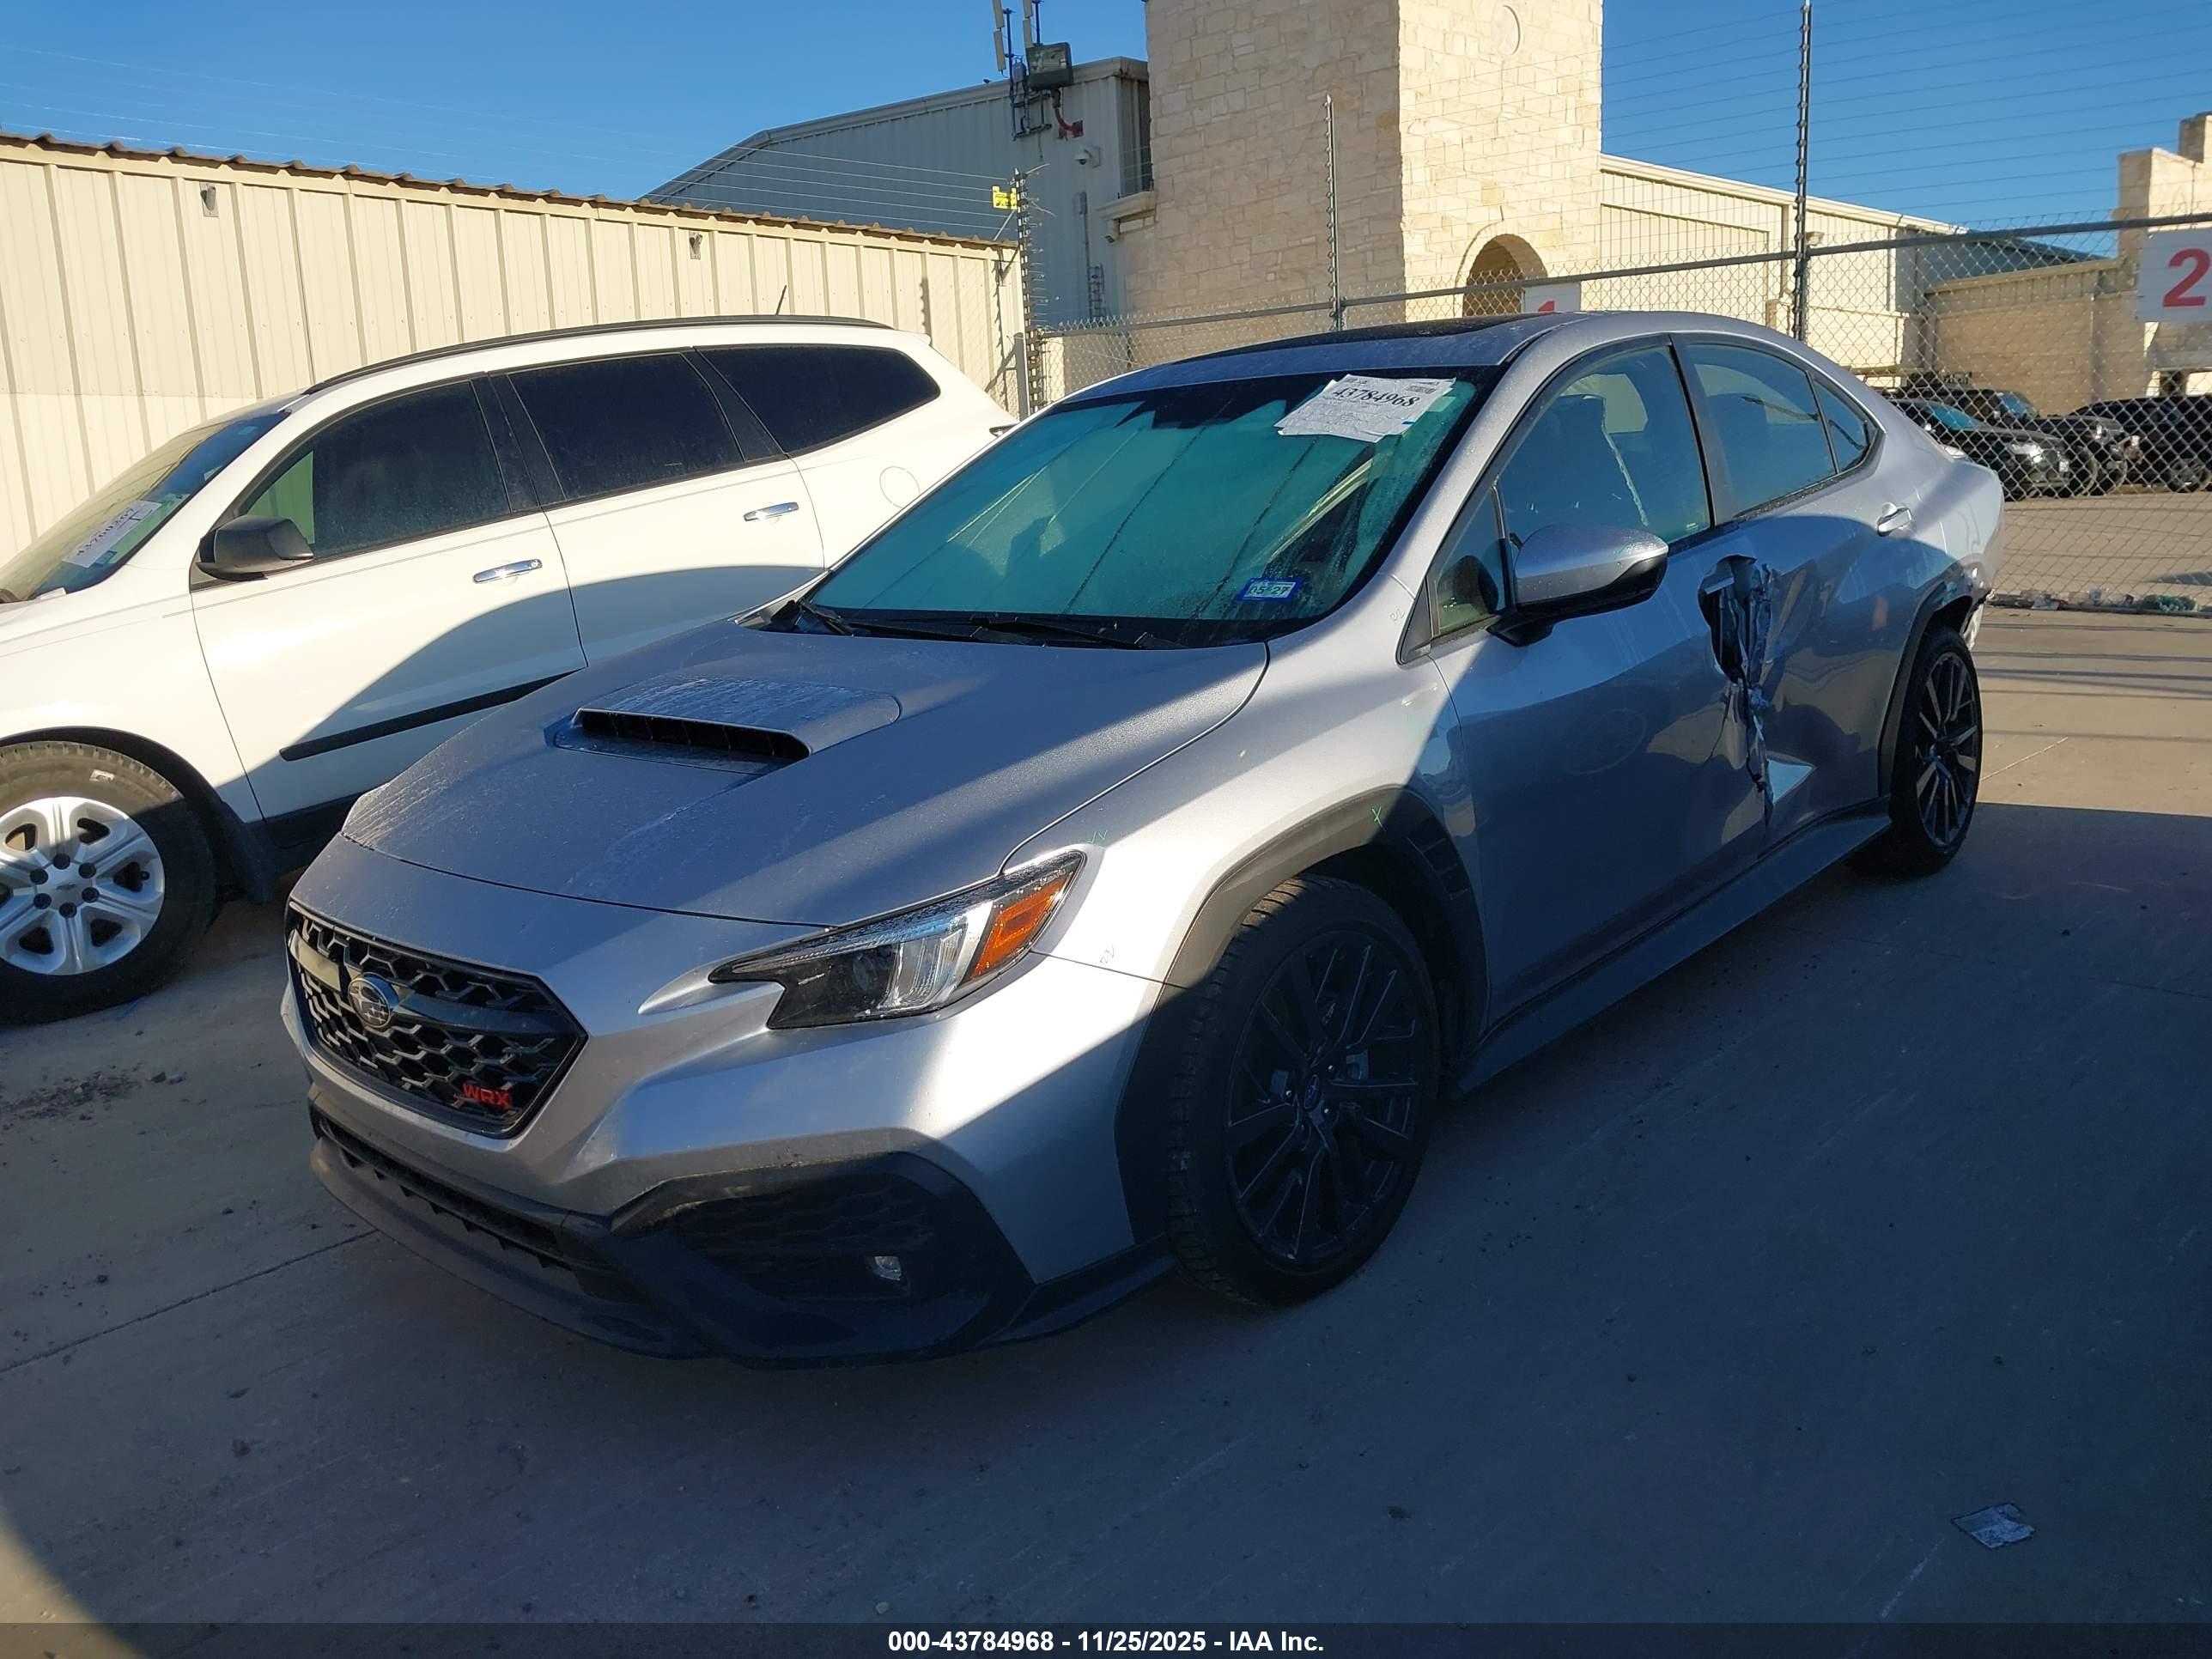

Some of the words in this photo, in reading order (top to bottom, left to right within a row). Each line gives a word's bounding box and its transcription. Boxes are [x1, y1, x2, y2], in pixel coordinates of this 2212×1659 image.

[2162, 248, 2210, 307] 2
[1333, 387, 1420, 407] 43784968
[463, 1084, 509, 1107] WRX
